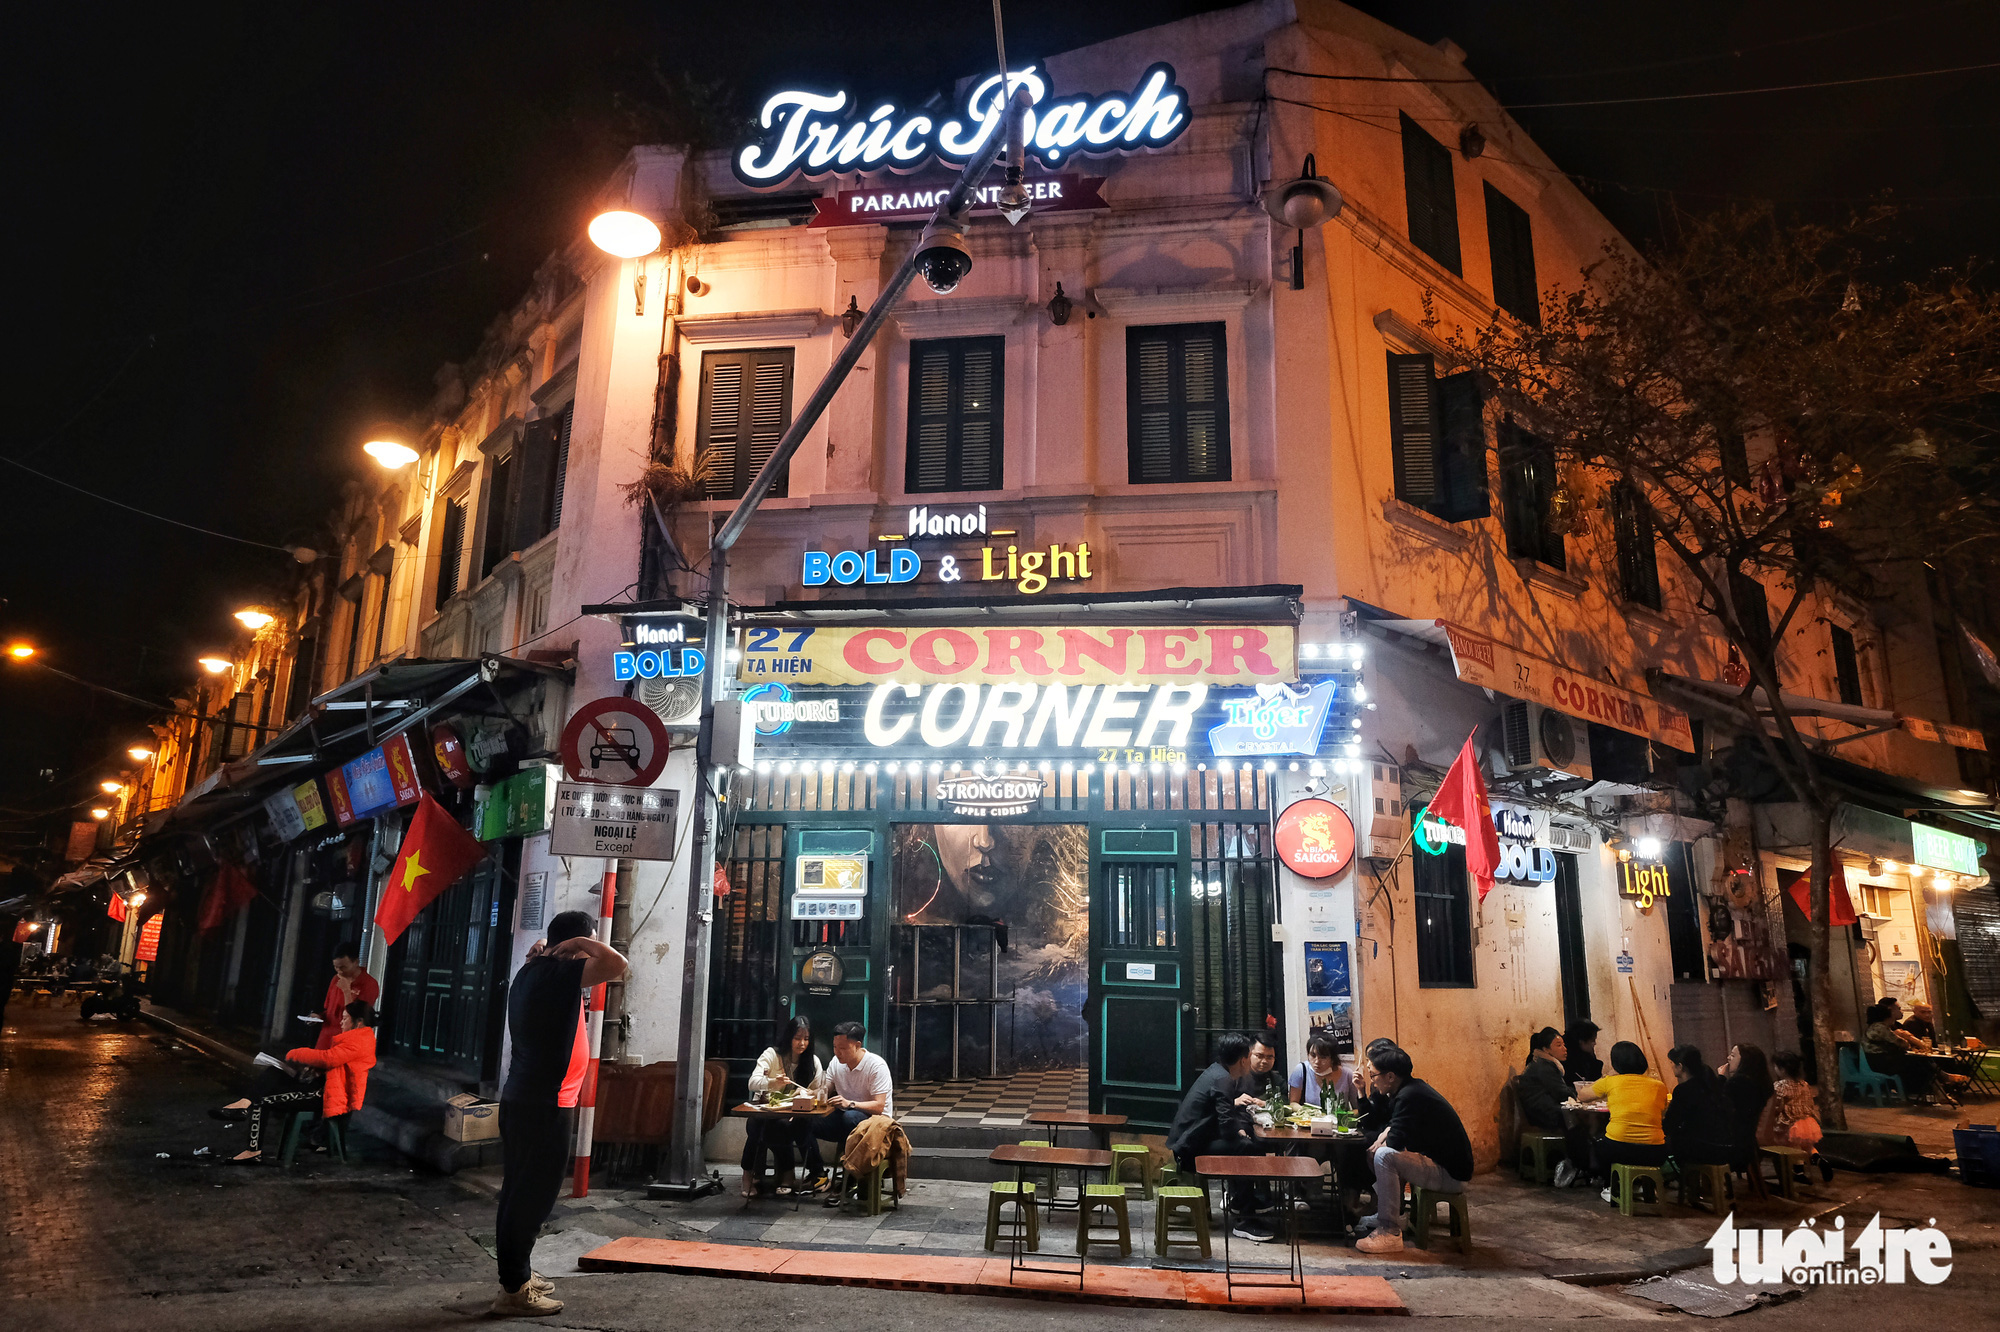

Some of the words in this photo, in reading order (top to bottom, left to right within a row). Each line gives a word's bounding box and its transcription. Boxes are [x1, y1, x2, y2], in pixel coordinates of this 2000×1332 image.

[739, 90, 931, 179] Trúc
[939, 65, 1184, 162] Bạch
[851, 186, 1001, 213] PARAMNT
[908, 504, 987, 538] Hanoi
[802, 548, 922, 587] BOLD
[938, 555, 962, 583] &
[980, 540, 1092, 595] Light
[636, 622, 686, 645] Hanoi
[613, 647, 706, 681] BOLD
[747, 628, 816, 652] 27
[843, 628, 1280, 676] CORNER
[747, 658, 767, 676] TẠ
[772, 656, 813, 676] HIỆN
[1515, 662, 1530, 682] 27
[752, 699, 840, 723] TUBORG
[863, 681, 1209, 748] CORNER
[1222, 696, 1314, 740] Tiger
[1552, 676, 1649, 733] CORNER
[1098, 748, 1117, 762] 27
[1235, 741, 1298, 752] CRYSTAL
[936, 782, 1042, 799] STRONGBOW
[954, 806, 986, 816] APPLE
[990, 805, 1028, 816] CIDERS
[1503, 810, 1536, 838] Hanoi
[594, 825, 623, 841] NGOẠI
[626, 825, 637, 841] LỆ
[1422, 820, 1467, 846] TUBOR
[595, 841, 633, 854] Except
[1927, 832, 1951, 860] BEER
[1952, 839, 1964, 863] 30
[1494, 842, 1557, 883] BOLD
[1623, 862, 1671, 908] Light
